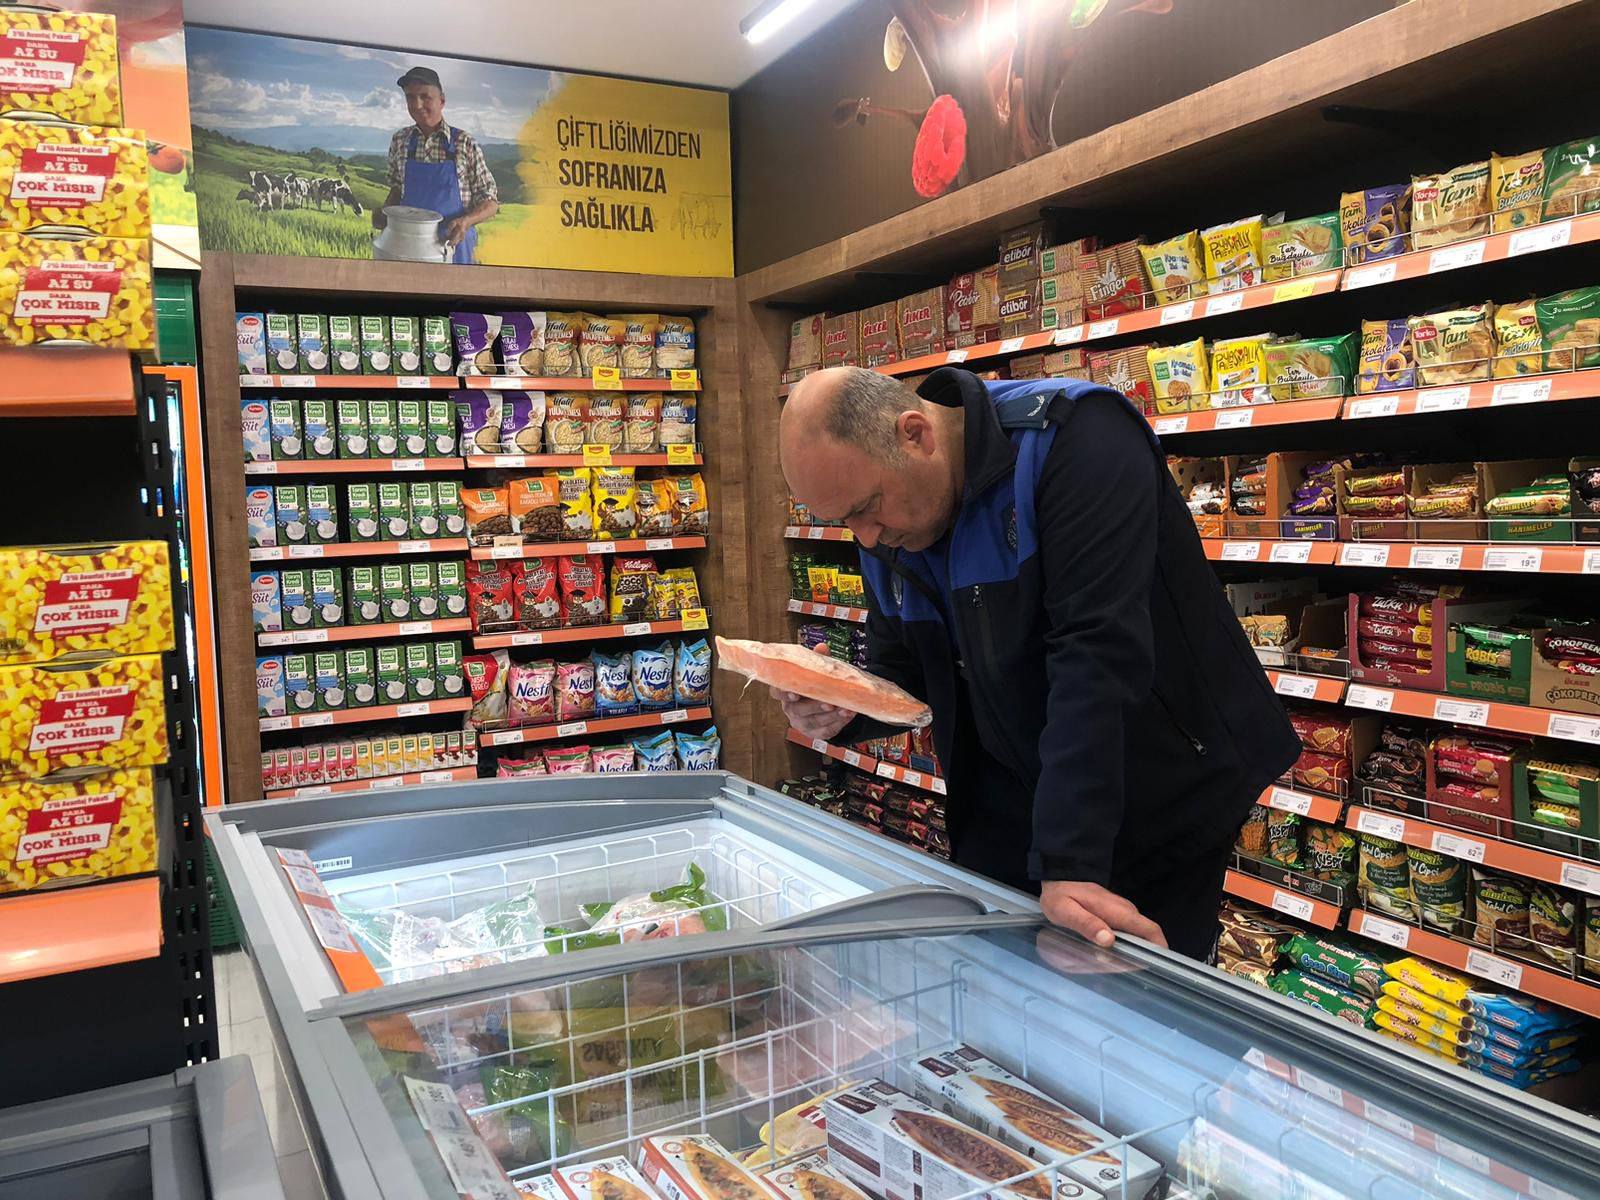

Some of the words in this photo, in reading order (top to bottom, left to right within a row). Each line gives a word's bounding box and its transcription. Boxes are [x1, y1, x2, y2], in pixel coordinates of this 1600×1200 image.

[14, 48, 34, 57] AZ
[39, 49, 58, 59] SU
[23, 69, 64, 80] MISIR
[557, 115, 701, 159] ÇİFTLİĞİMİZDEN
[44, 162, 64, 171] AZ
[69, 163, 88, 172] SU
[559, 159, 667, 193] SOFRANIZA
[17, 181, 48, 192] ÇOK
[53, 183, 95, 194] MISIR
[1416, 190, 1438, 200] Torku
[1440, 184, 1476, 207] Tam
[561, 197, 654, 232] SAĞLIKLA
[1342, 206, 1361, 220] Tam
[1004, 246, 1031, 263] etibör
[48, 279, 69, 289] AZ
[73, 280, 93, 289] SU
[1090, 275, 1126, 301] Finger
[21, 300, 52, 310] ÇOK
[58, 301, 100, 310] MISIR
[1000, 298, 1028, 316] etibör
[903, 306, 932, 327] ÜLKER
[588, 323, 612, 333] Lifalif
[664, 323, 685, 333] Lifalif
[864, 320, 888, 338] ÜLKER
[237, 334, 254, 344] Süt
[826, 332, 847, 347] ÜLKER
[1363, 334, 1382, 344] Tam
[1440, 329, 1469, 348] Tam
[554, 398, 574, 407] Lifalif
[592, 399, 613, 408] Lifalif
[242, 421, 259, 432] Süt
[247, 508, 263, 518] Süt
[624, 560, 652, 570] Kellogg's
[68, 591, 89, 600] AZ
[93, 589, 112, 598] SU
[252, 593, 269, 603] Süt
[42, 612, 72, 624] ÇOK
[77, 609, 119, 620] MISIR
[1549, 639, 1600, 654] ÇOKOPREN
[257, 678, 273, 688] Süt
[1546, 689, 1600, 705] ÇOKOPREN
[63, 709, 84, 718] AZ
[88, 706, 108, 715] SU
[36, 731, 66, 744] ÇOK
[72, 726, 115, 737] MISIR
[50, 819, 71, 828] AZ
[75, 814, 94, 824] SU
[23, 840, 53, 853] ÇOK
[60, 834, 101, 846] MISIR
[1501, 971, 1510, 979] 21
